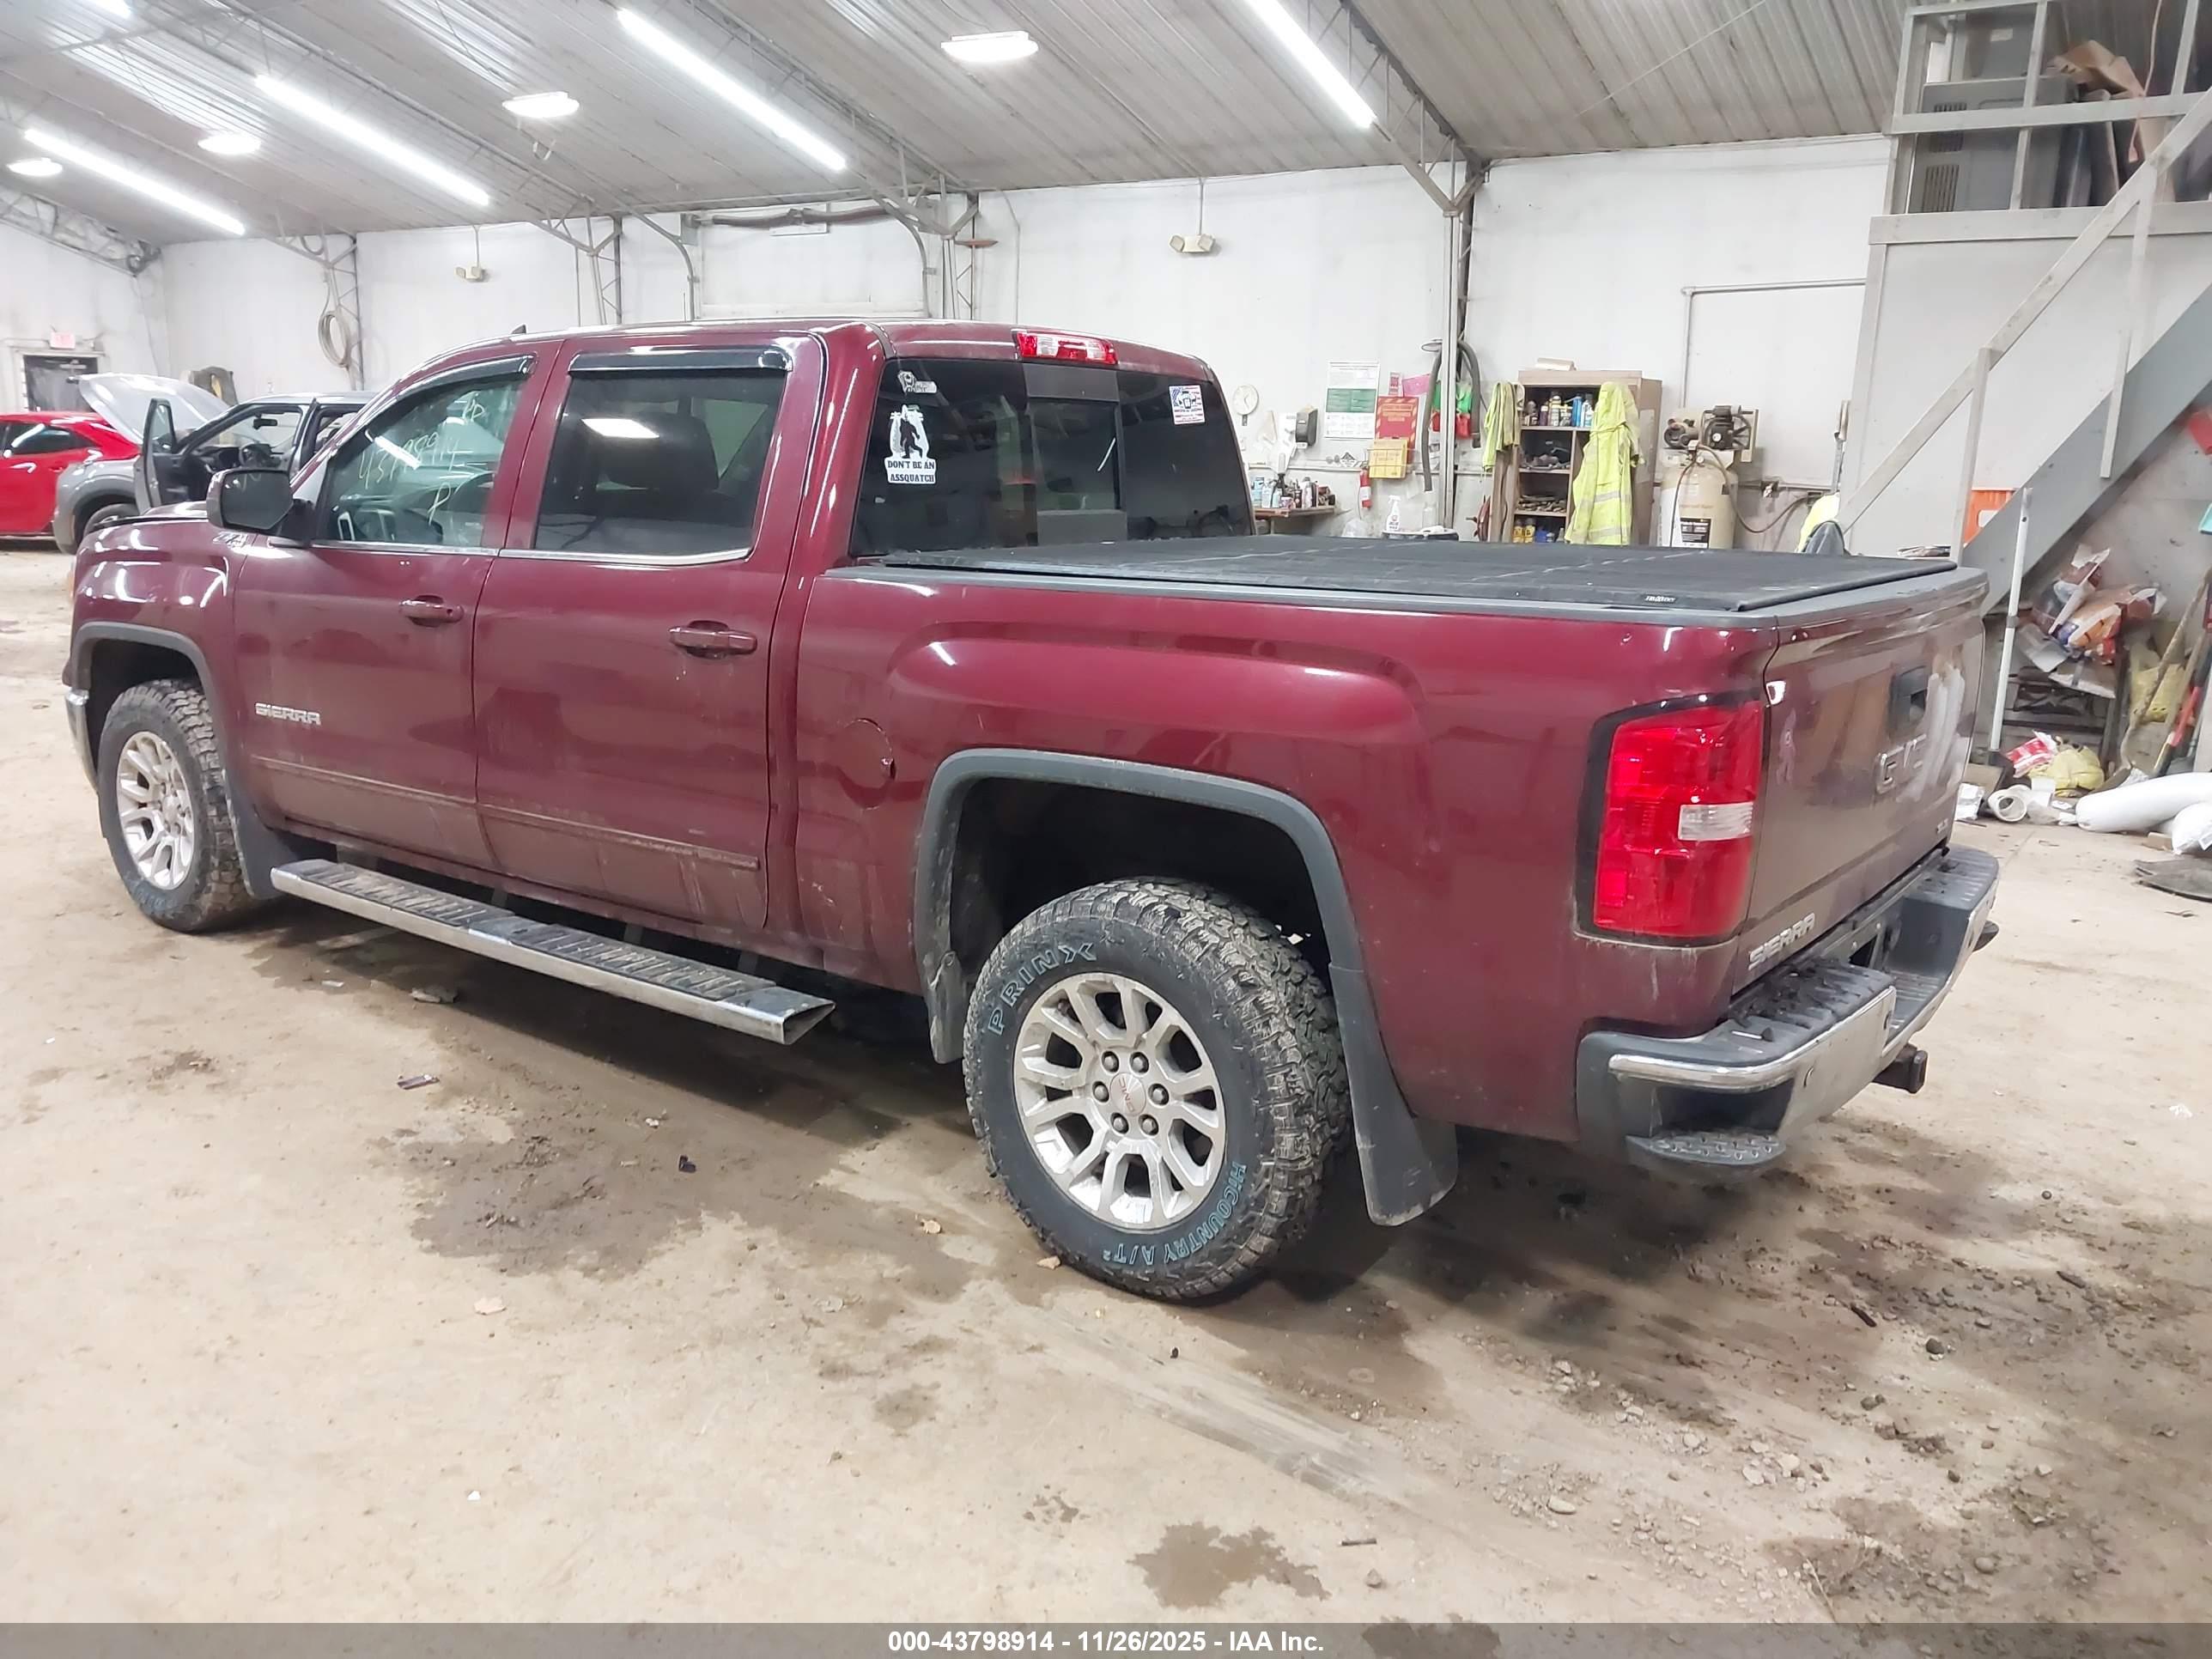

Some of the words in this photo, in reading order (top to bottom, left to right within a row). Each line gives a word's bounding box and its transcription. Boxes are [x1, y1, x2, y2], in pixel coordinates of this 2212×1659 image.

[887, 460, 910, 469] DON'T
[924, 461, 935, 470] AN
[890, 473, 934, 483] ASSQUATCH
[255, 702, 321, 726] SIERRA
[1747, 912, 1815, 970] SIERRA
[988, 943, 1097, 1036] PRINX
